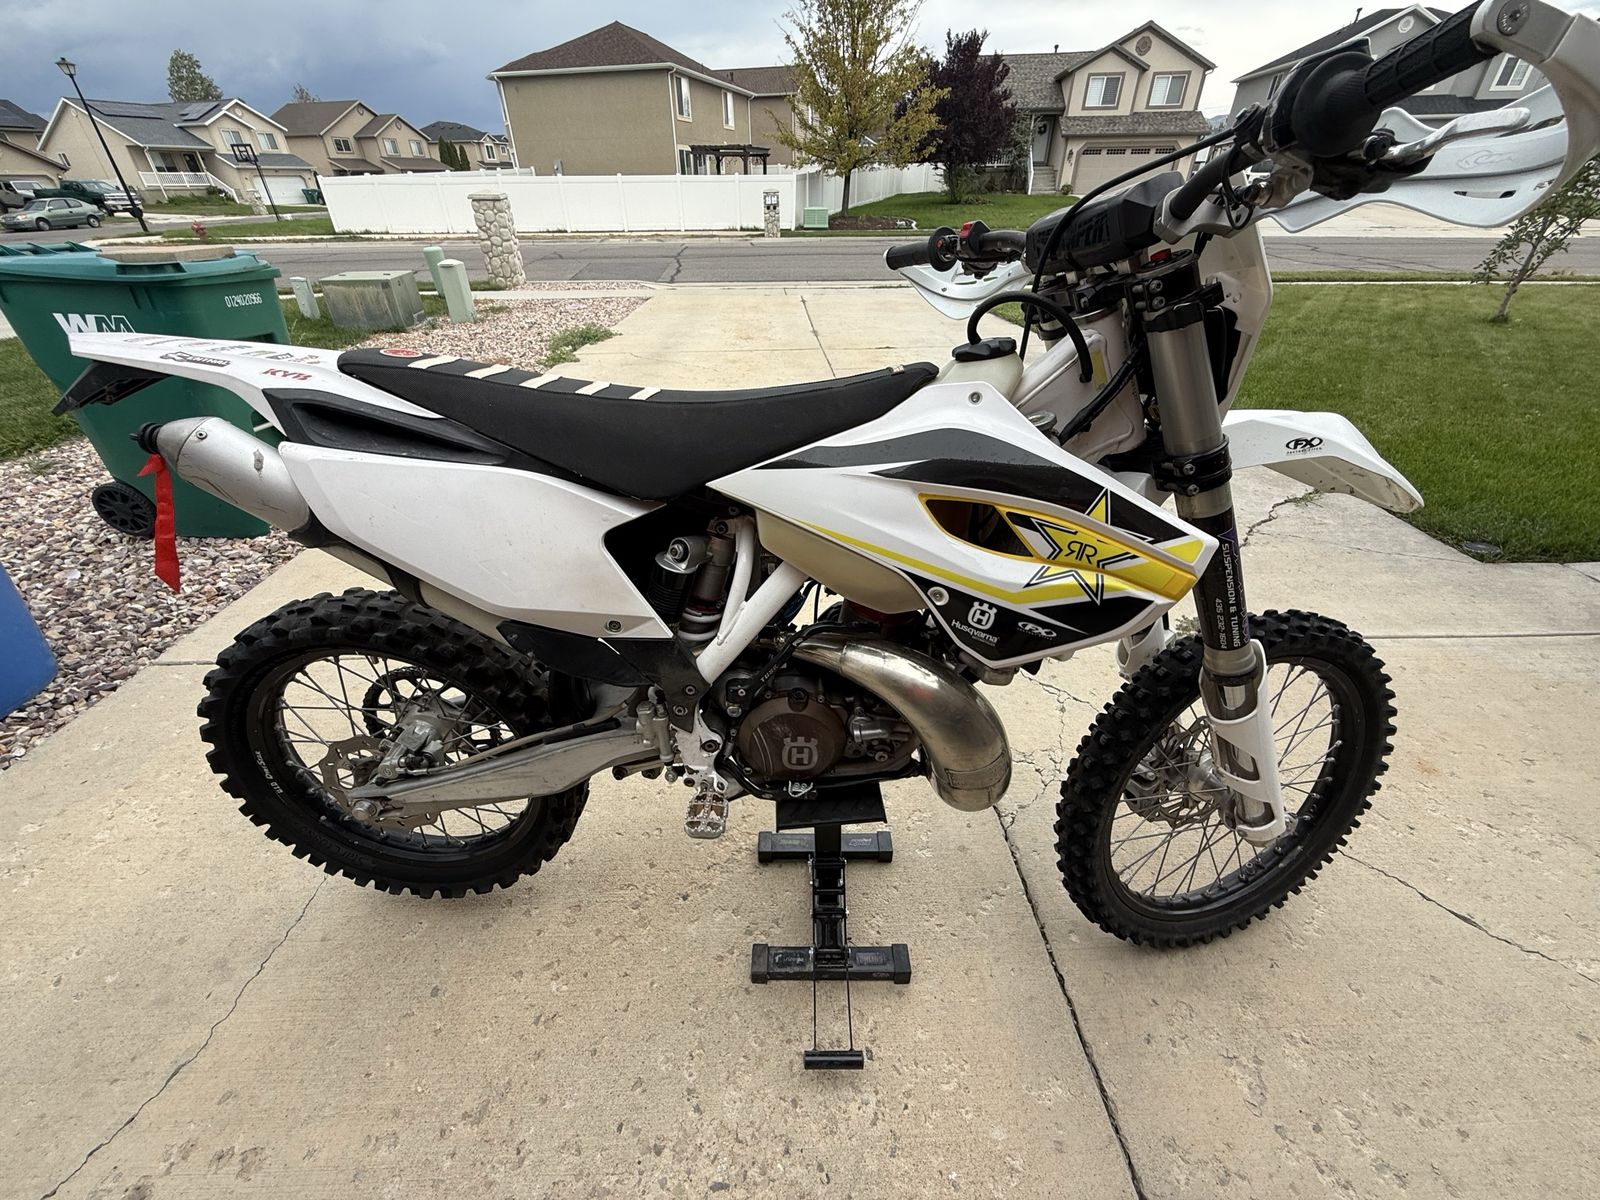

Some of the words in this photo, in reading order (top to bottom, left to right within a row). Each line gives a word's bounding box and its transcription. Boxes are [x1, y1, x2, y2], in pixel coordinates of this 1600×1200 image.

[263, 367, 313, 382] KYB
[1221, 543, 1237, 604] SUSPENSION
[1230, 615, 1241, 648] TUNING
[951, 619, 999, 644] Husqvarna
